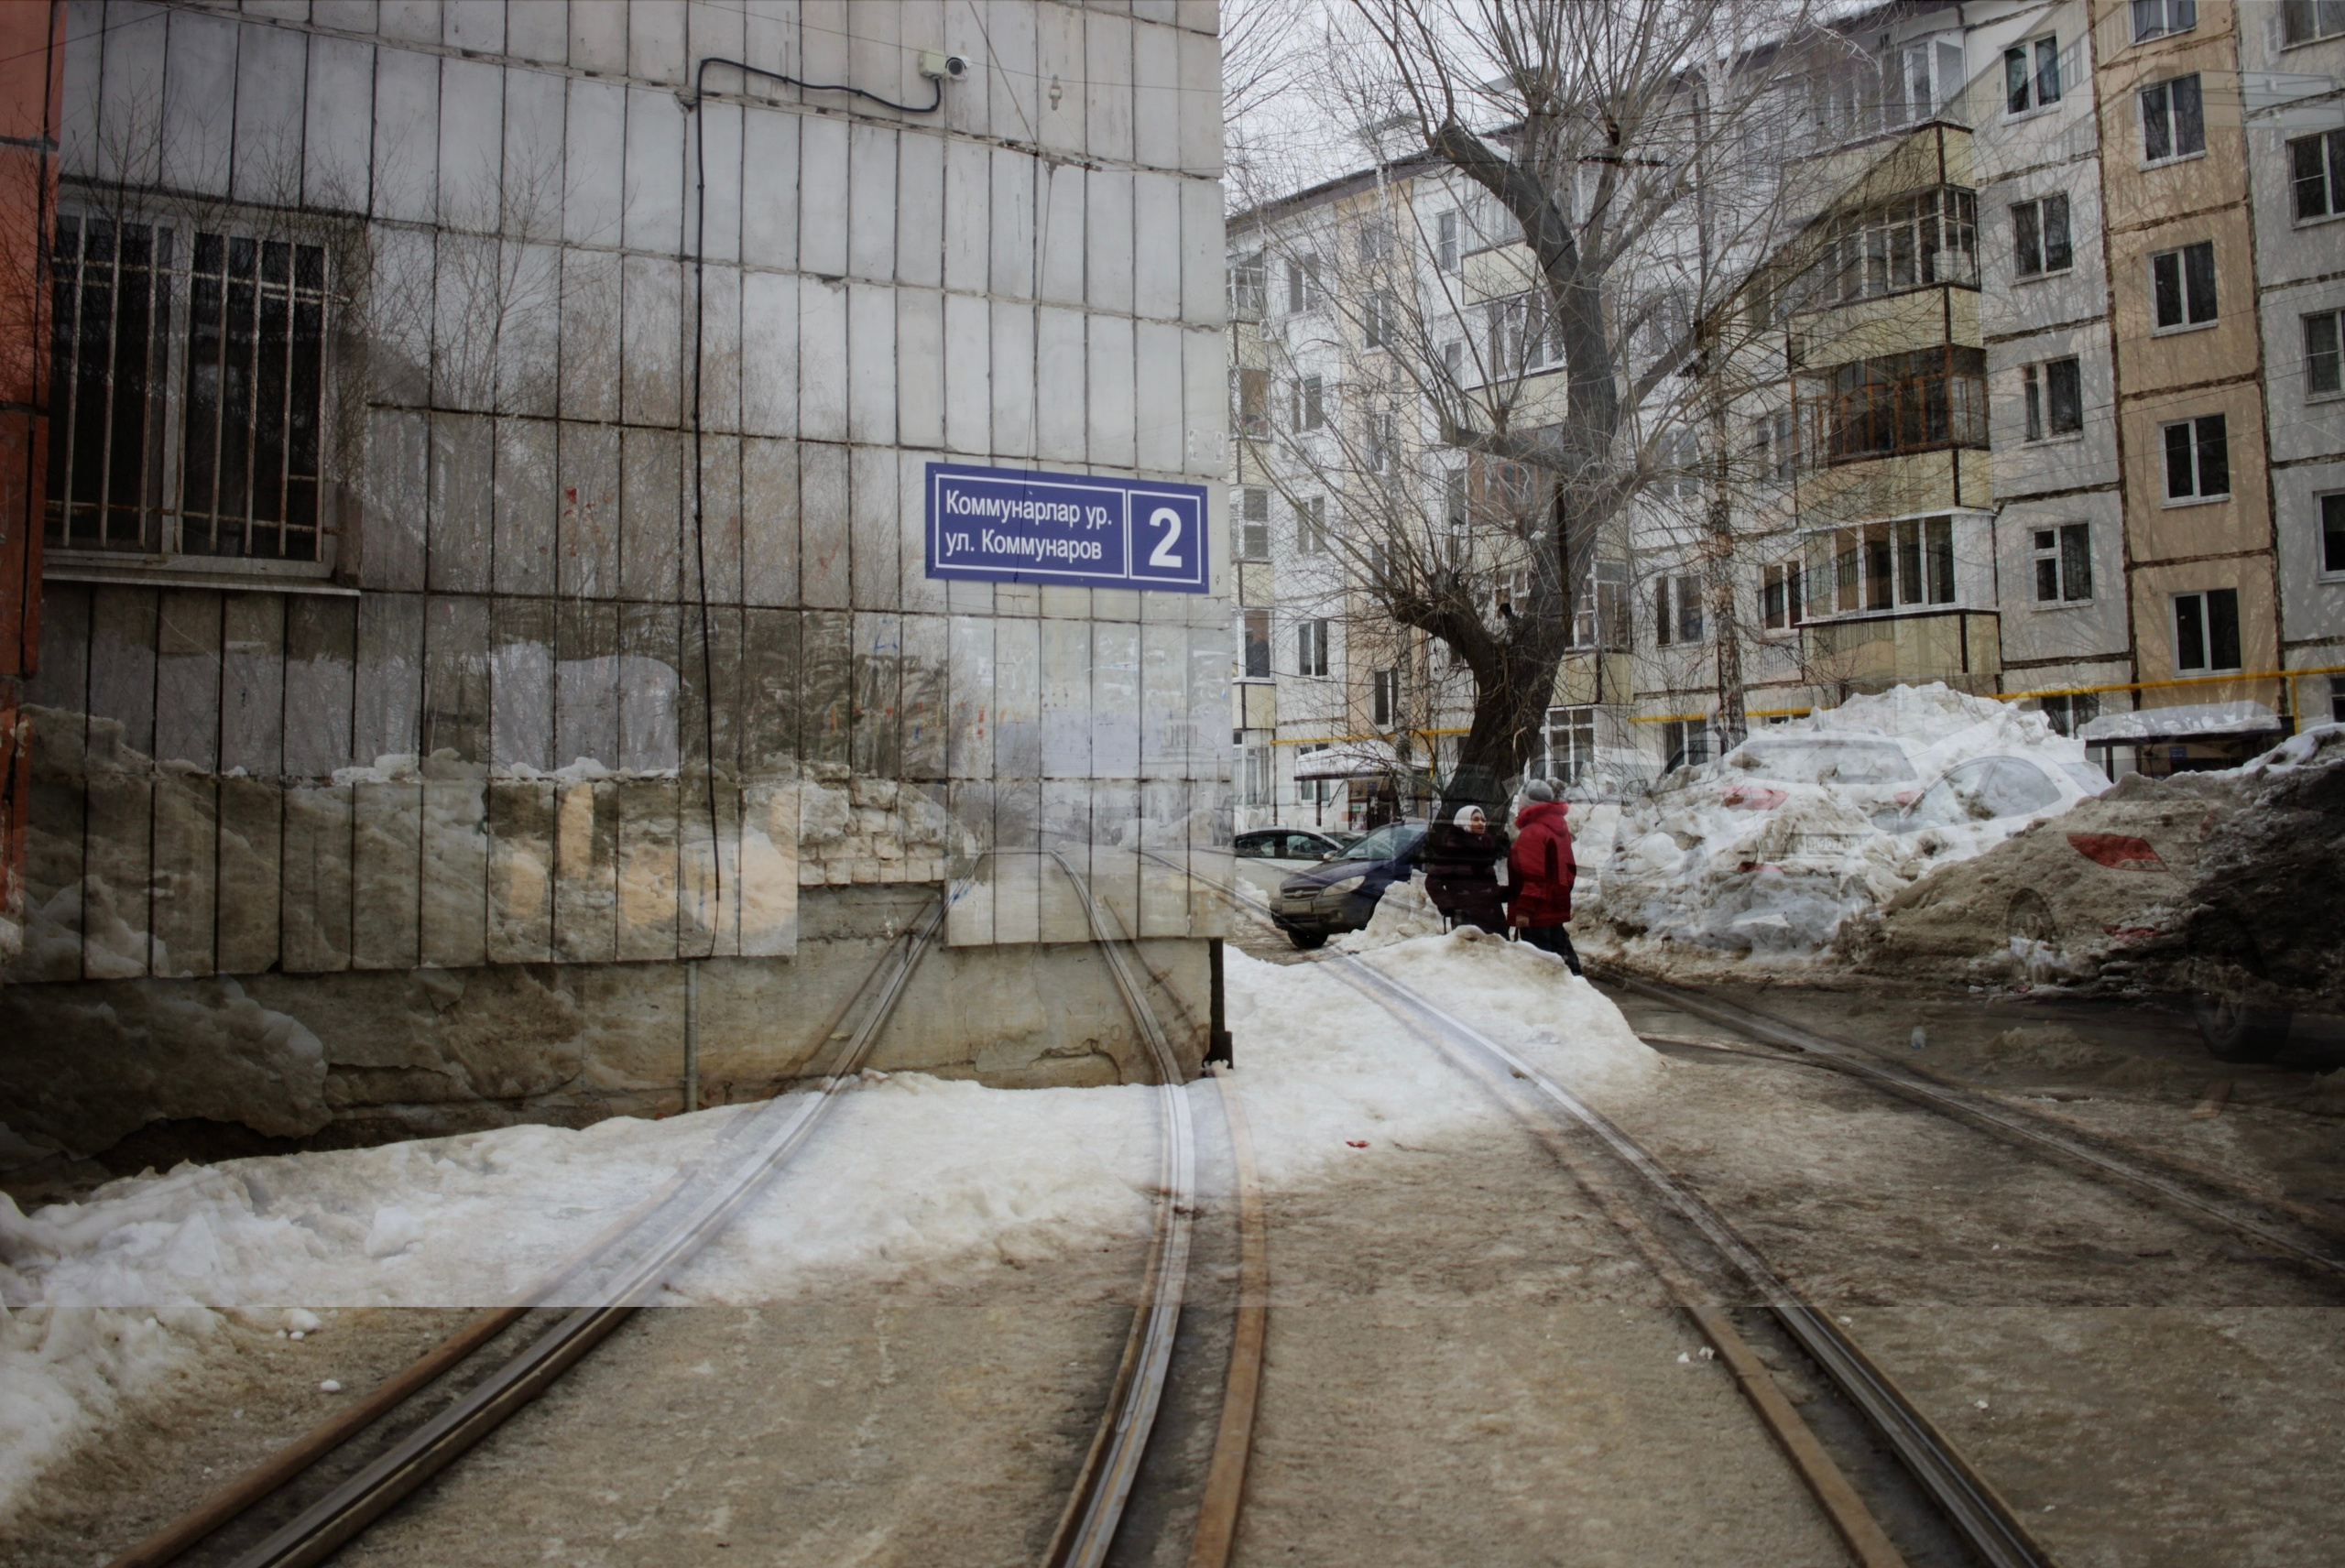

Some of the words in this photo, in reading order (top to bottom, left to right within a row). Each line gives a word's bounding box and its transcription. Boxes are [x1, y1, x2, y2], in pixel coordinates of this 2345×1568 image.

[946, 489, 1080, 528] Коммунарлар
[1085, 506, 1113, 530] ур.
[945, 531, 975, 557] ул.
[982, 528, 1103, 564] Коммунаров
[1149, 506, 1183, 568] 2
